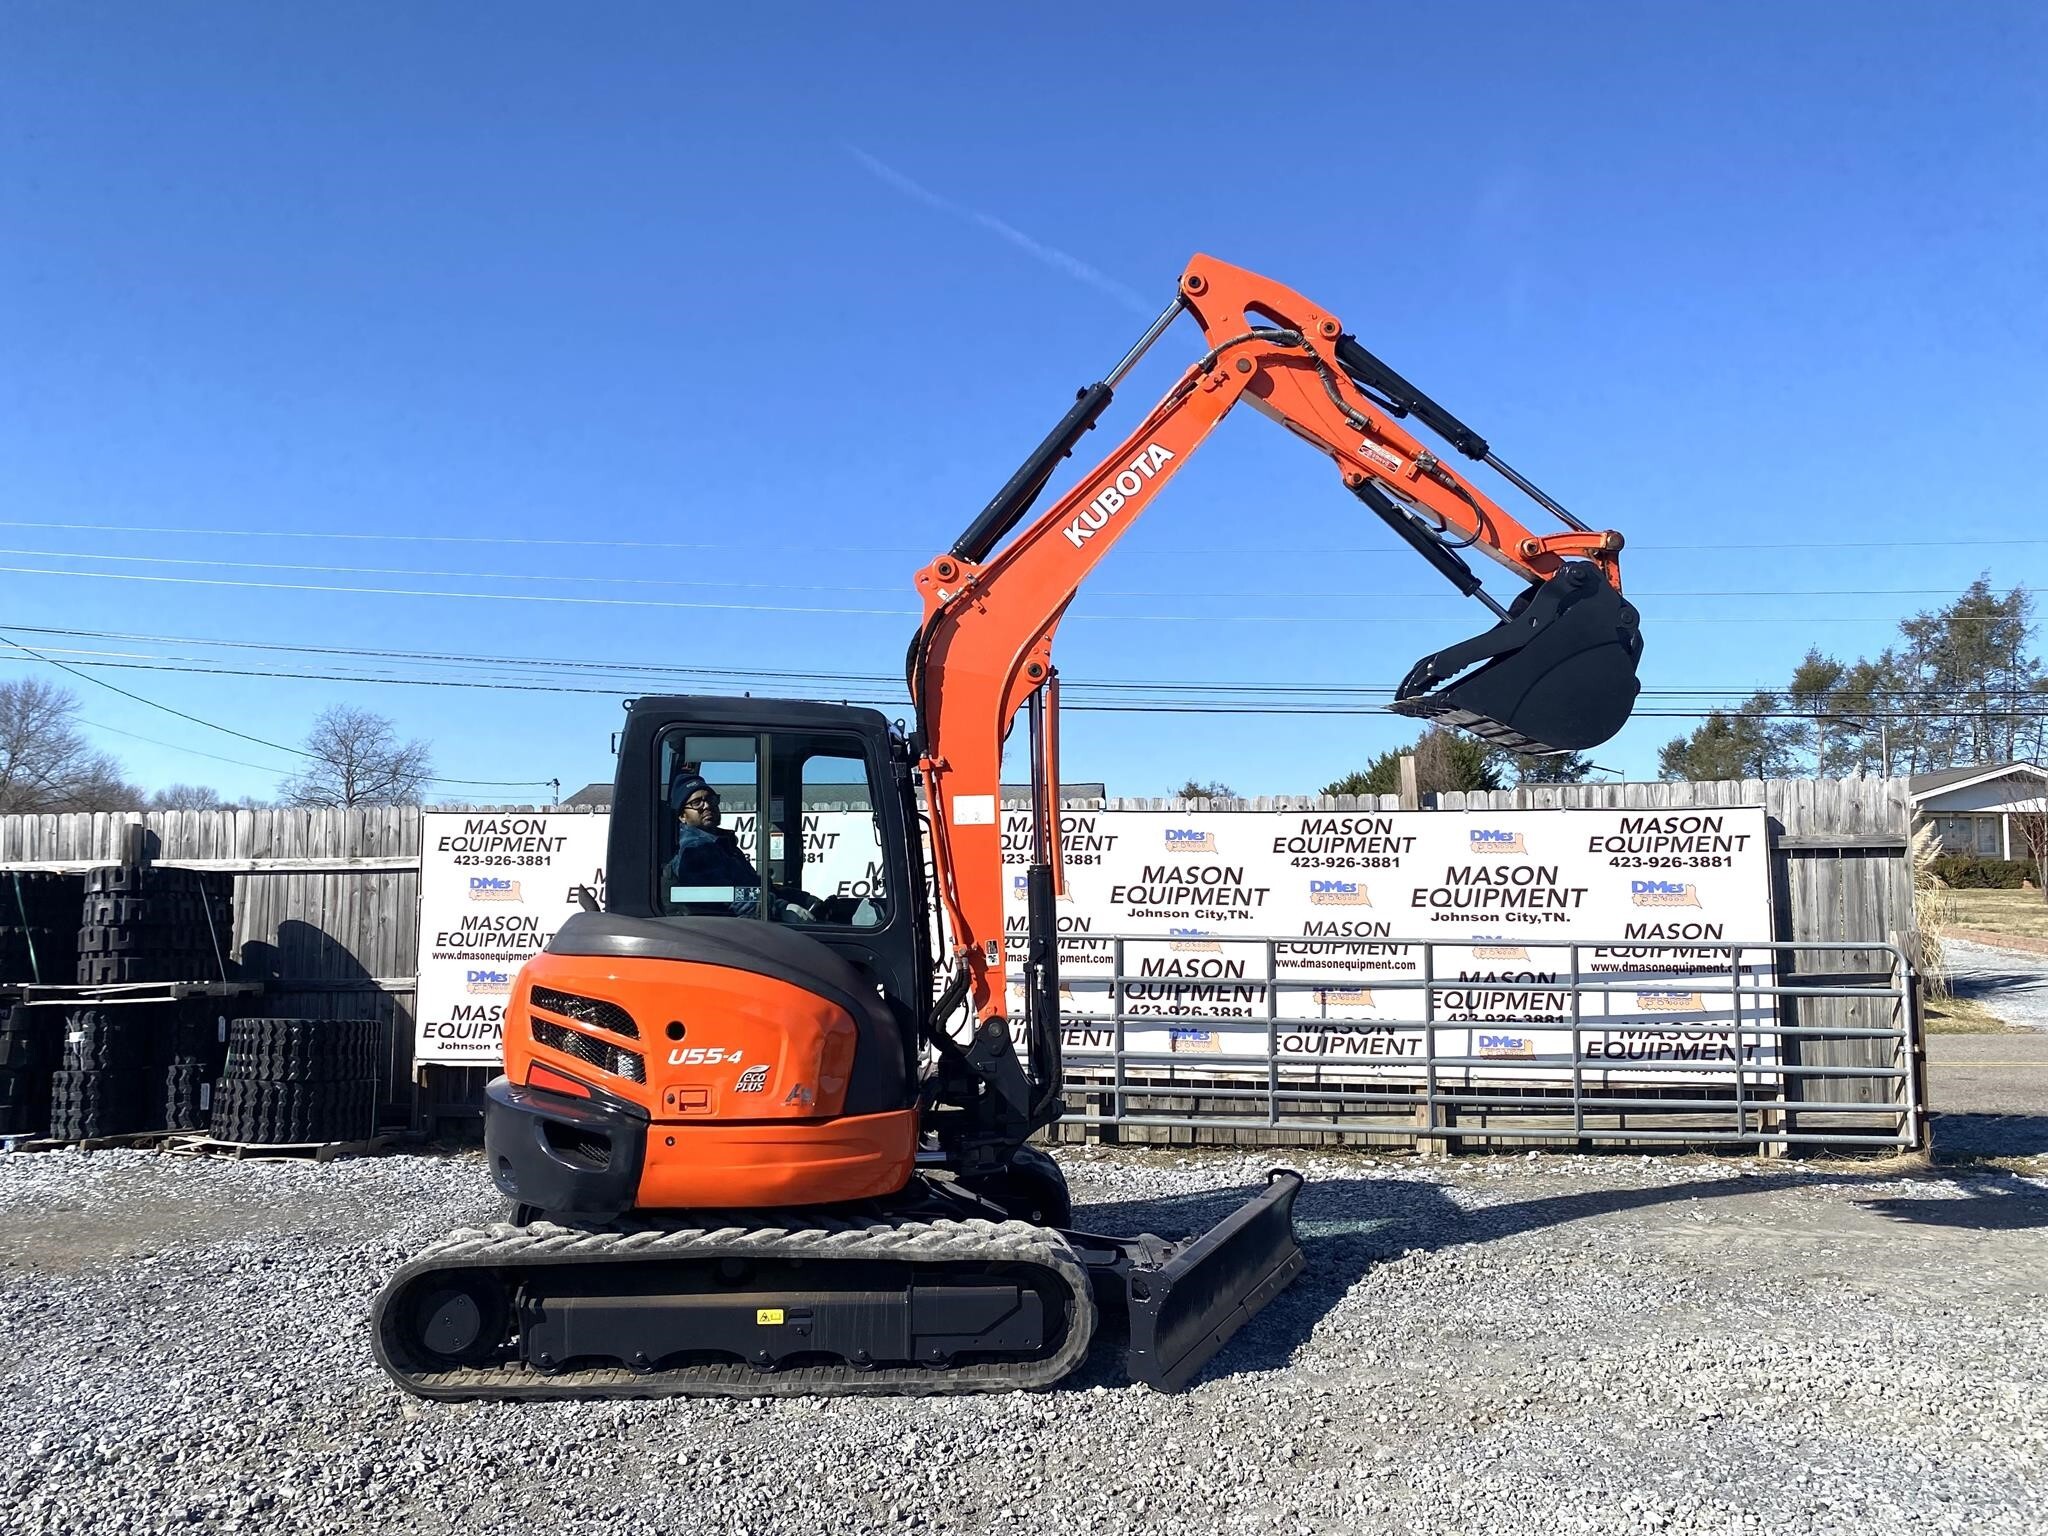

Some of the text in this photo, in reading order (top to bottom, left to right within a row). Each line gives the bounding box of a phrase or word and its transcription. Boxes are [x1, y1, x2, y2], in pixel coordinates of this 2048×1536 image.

[1062, 443, 1176, 549] KUBOTA
[464, 819, 546, 835] MASON
[1007, 816, 1096, 833] MON
[1300, 818, 1393, 835] MASON
[1619, 816, 1723, 834] MASON
[438, 836, 567, 853] EQUIPMENT
[1273, 836, 1416, 853] EQUIPMENT
[1588, 835, 1750, 853] EQUIPMENT
[453, 855, 551, 866] 423-926-3881
[1291, 857, 1400, 868] 423-926-3881
[1609, 856, 1732, 868] 423-926-3881
[1141, 866, 1244, 885] MASON
[1445, 866, 1558, 885] MASON
[1110, 886, 1270, 907] EQUIPMENT
[1411, 887, 1588, 908] EQUIPMENT
[1127, 908, 1189, 918] Johnson
[1431, 912, 1499, 922] Johnson
[460, 916, 539, 931] MASON
[1006, 916, 1091, 932] MON
[1303, 921, 1391, 937] MASON
[1624, 923, 1723, 940] MASON
[1140, 958, 1245, 978] MASON
[1591, 961, 1752, 975] www.dmasonequipment.cm
[1459, 971, 1556, 984] MASON
[437, 1042, 490, 1050] Johnson
[1585, 1041, 1760, 1061] EQUIPMENT
[668, 1048, 743, 1065] U55-4
[734, 1082, 764, 1093] PLUS
